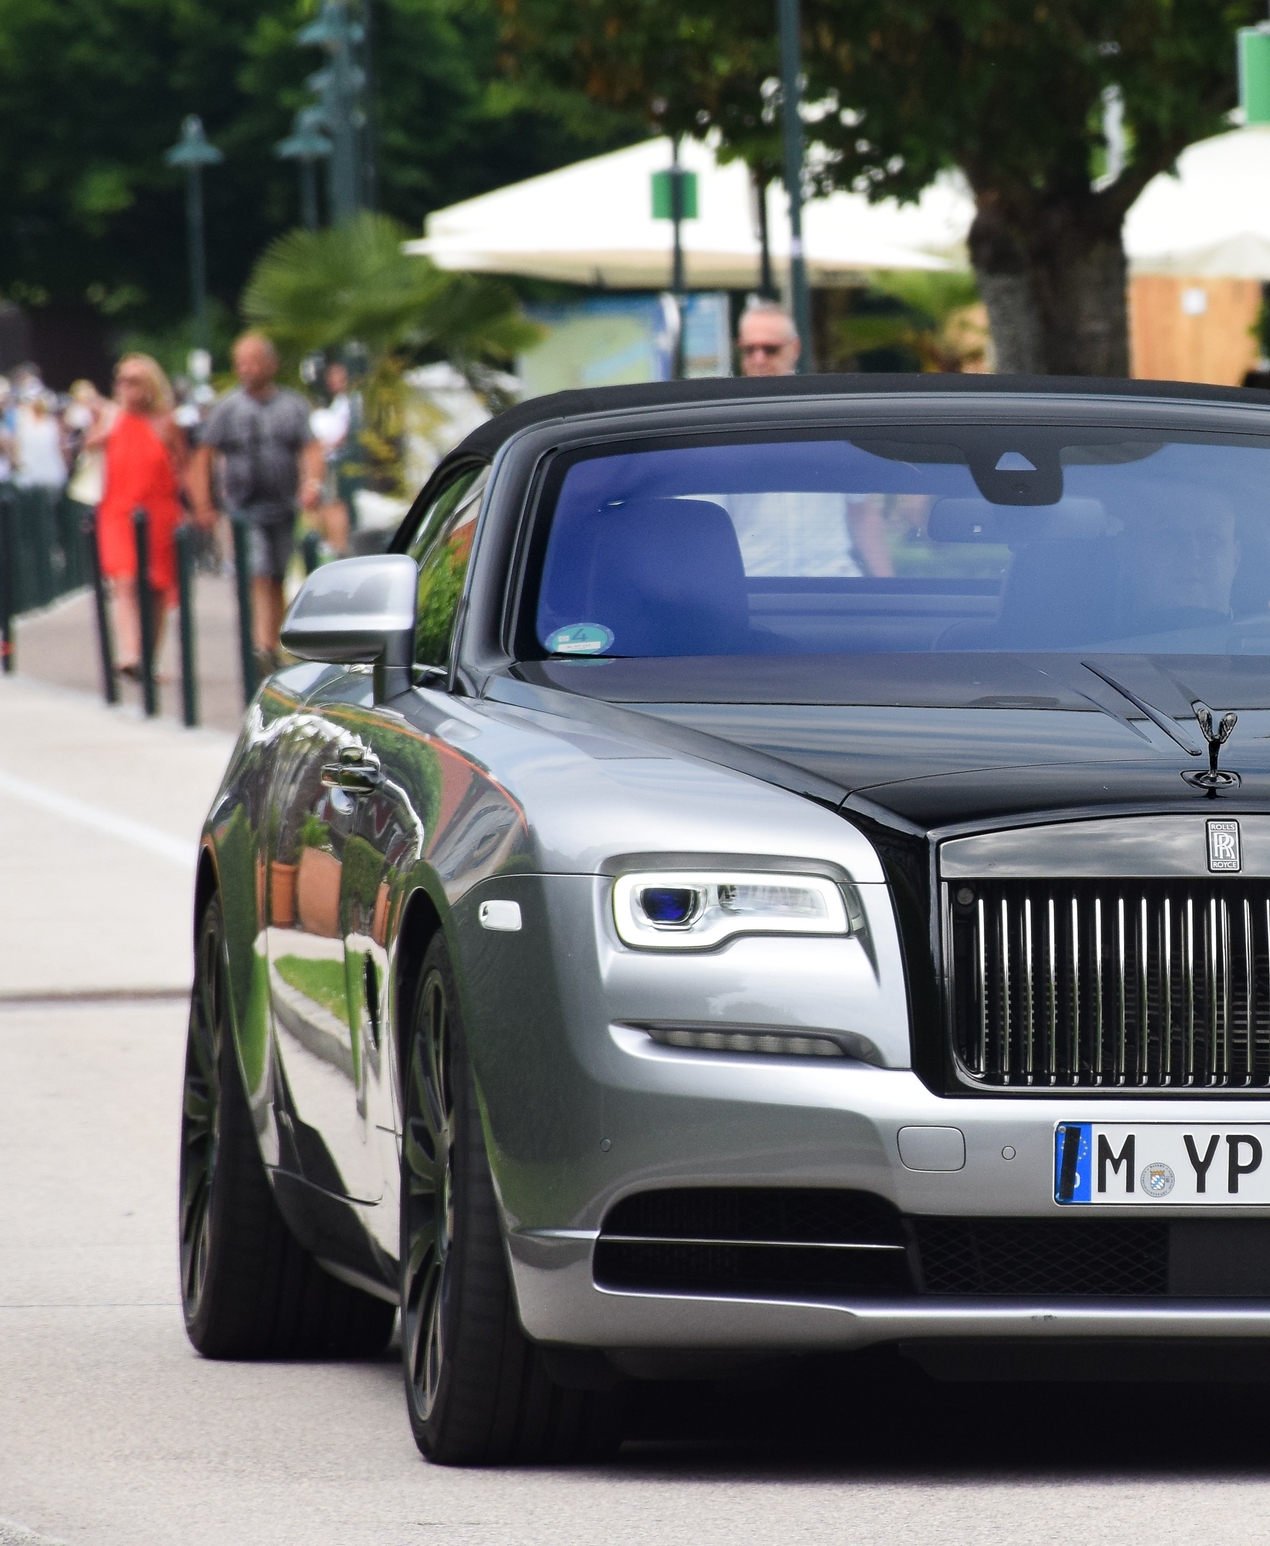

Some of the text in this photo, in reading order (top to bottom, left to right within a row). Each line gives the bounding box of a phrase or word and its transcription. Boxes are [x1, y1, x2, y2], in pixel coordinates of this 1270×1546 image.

[1213, 832, 1235, 859] RR
[1097, 1134, 1136, 1193] M
[1183, 1134, 1263, 1194] YP
